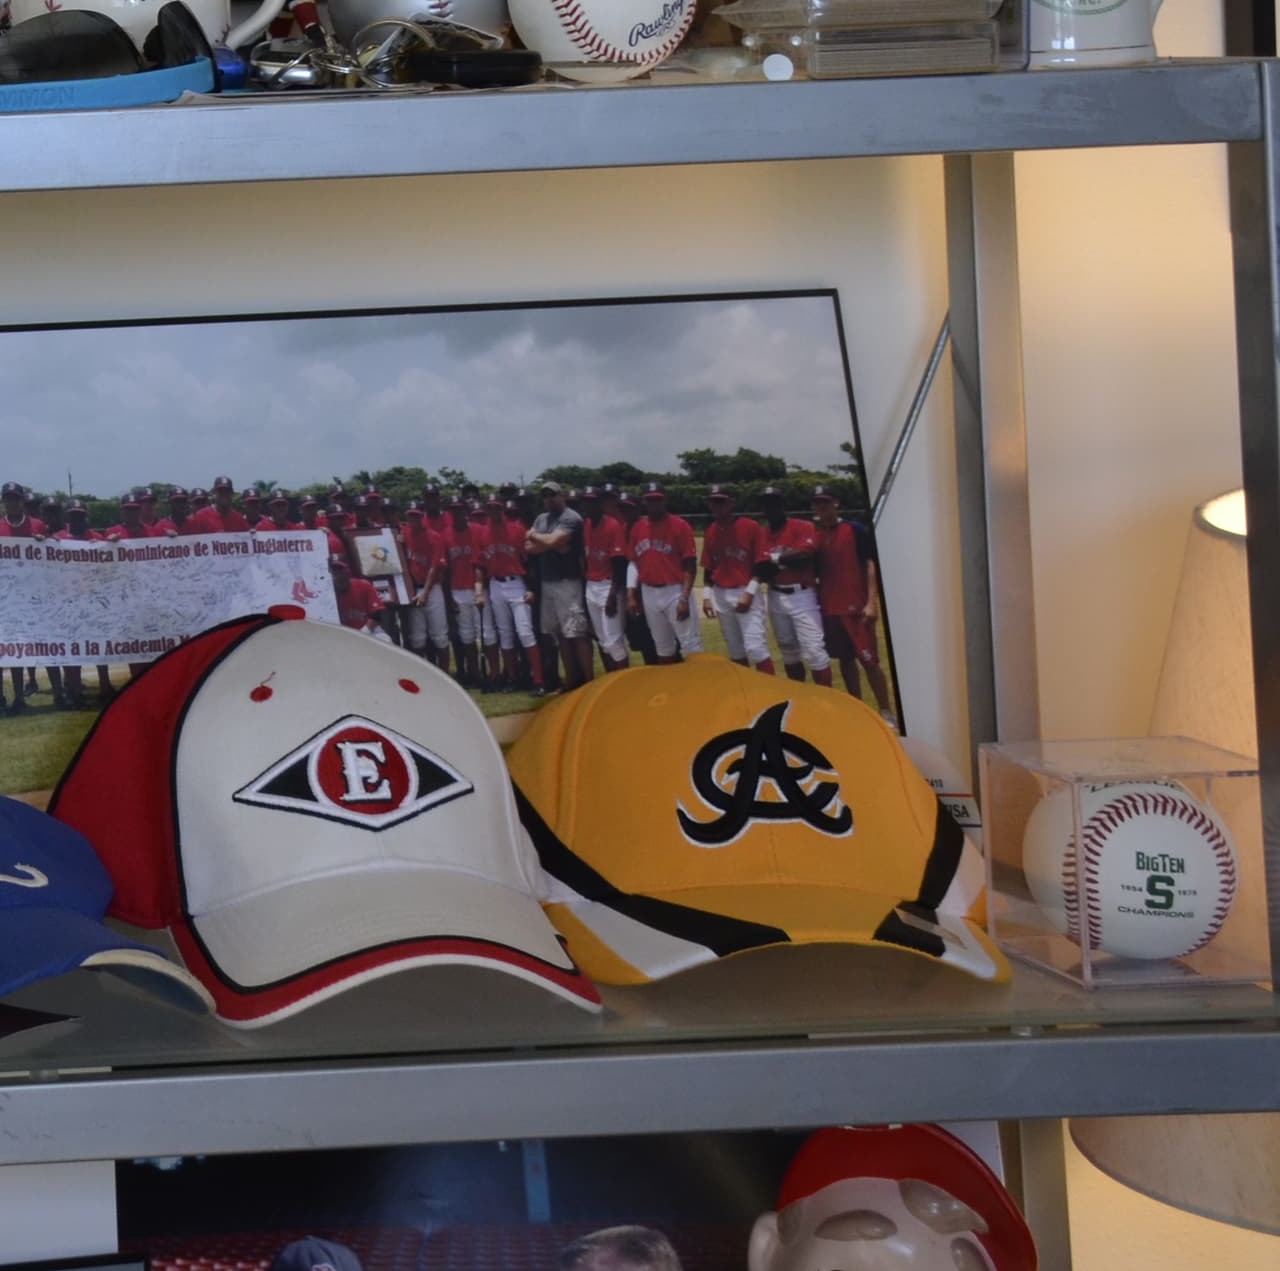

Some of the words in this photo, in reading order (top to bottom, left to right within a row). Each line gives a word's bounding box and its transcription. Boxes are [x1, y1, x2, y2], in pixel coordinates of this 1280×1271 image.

[25, 544, 42, 560] de
[46, 546, 115, 564] Republica
[117, 544, 192, 562] Dominicano
[194, 541, 209, 558] de
[211, 539, 250, 556] Nueva
[252, 537, 315, 556] Inglaterra
[70, 644, 82, 657] a
[85, 638, 101, 657] la
[103, 636, 178, 657] Academia
[336, 739, 391, 804] E
[1144, 874, 1176, 911] S
[1117, 905, 1196, 920] CHAMPIONS
